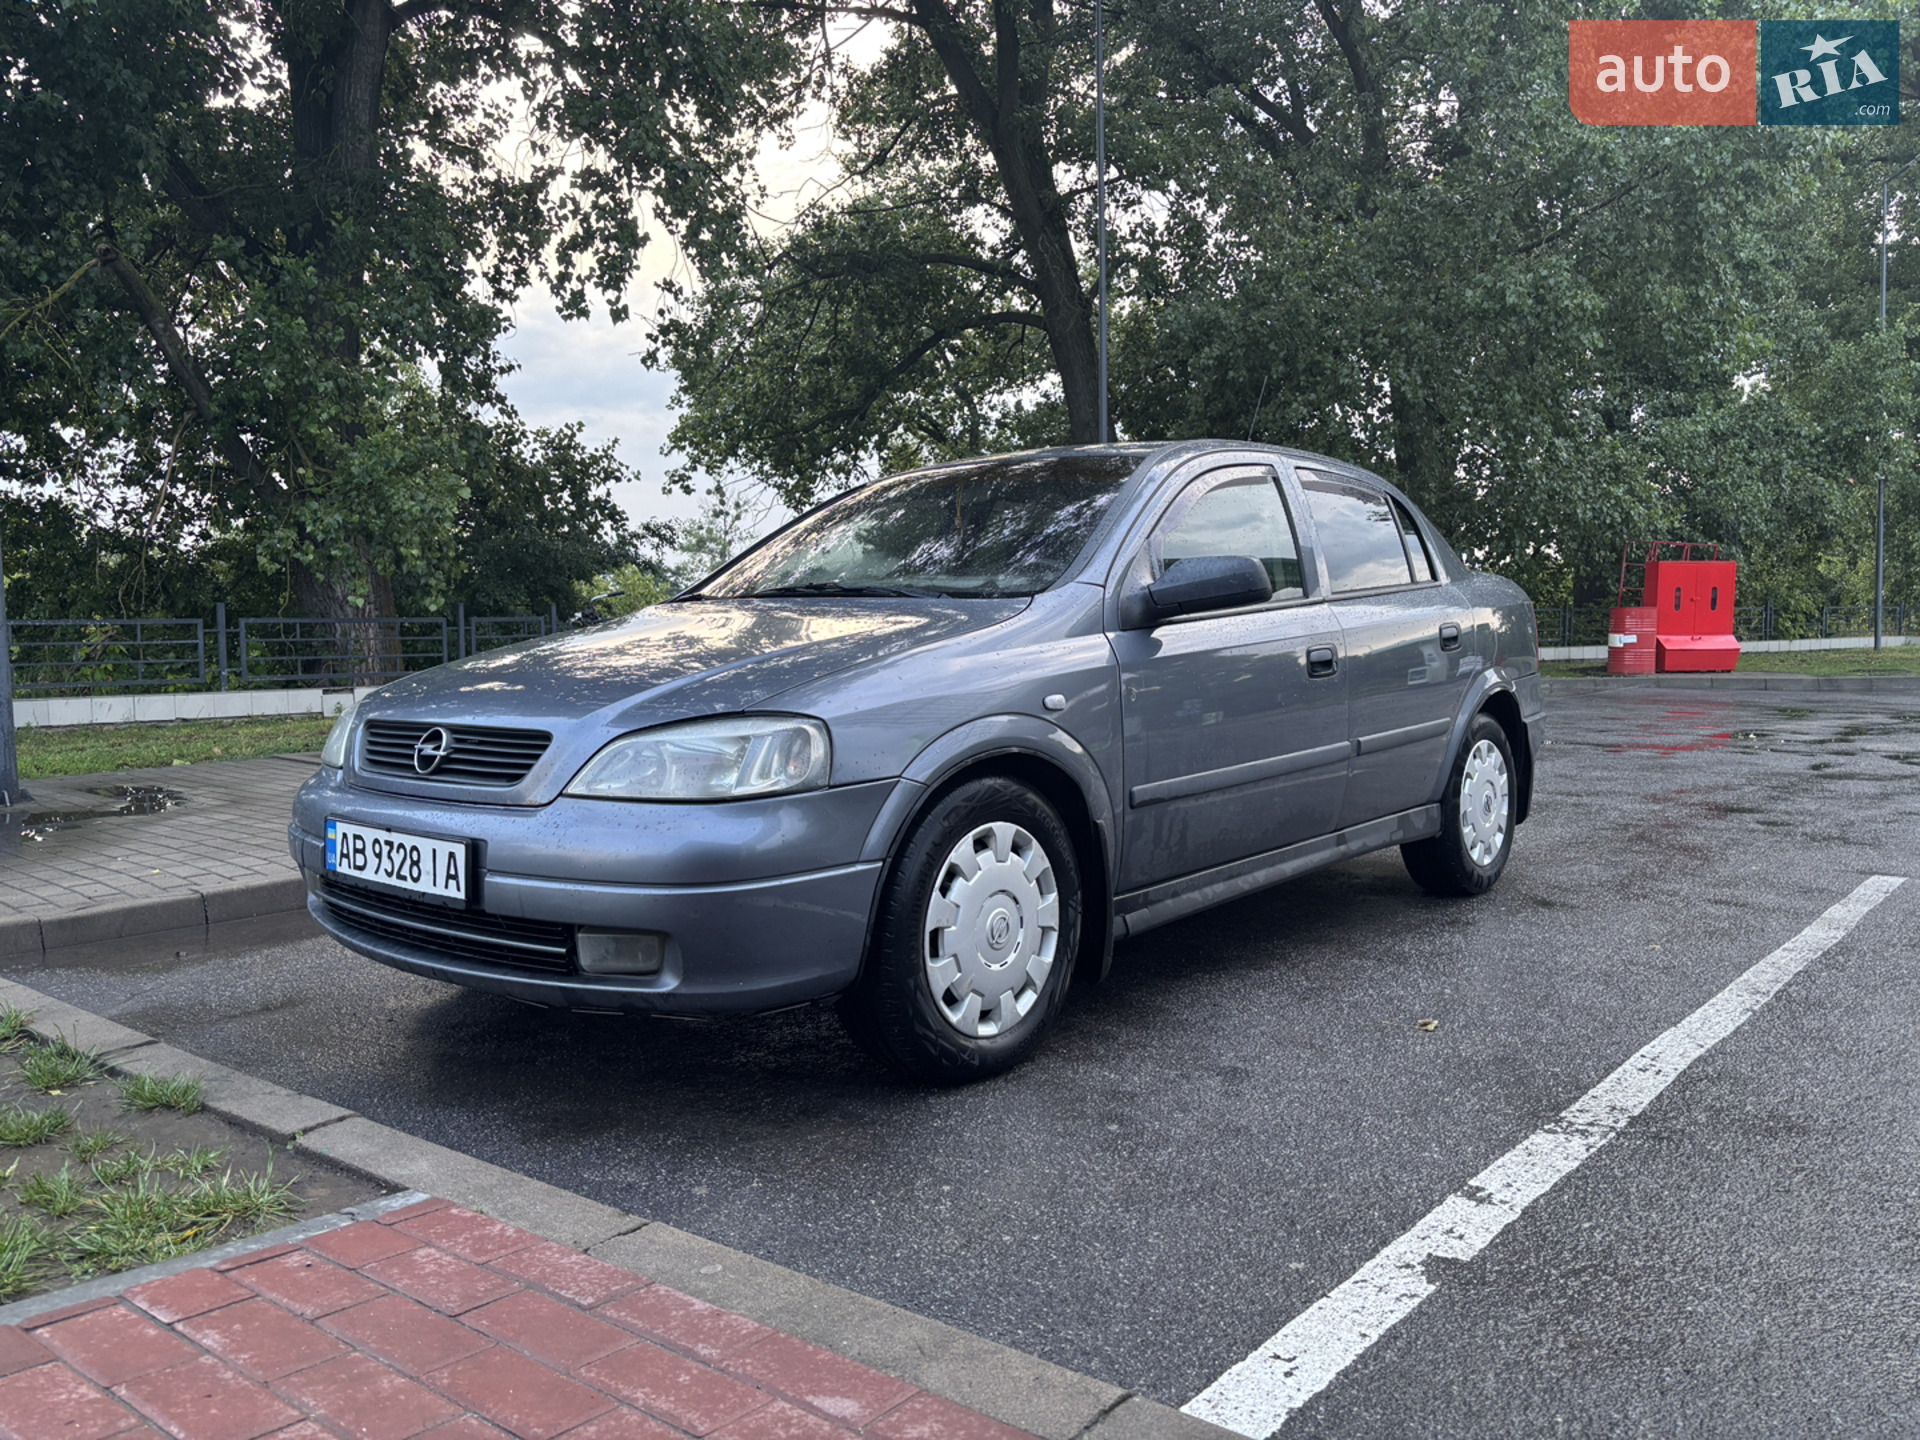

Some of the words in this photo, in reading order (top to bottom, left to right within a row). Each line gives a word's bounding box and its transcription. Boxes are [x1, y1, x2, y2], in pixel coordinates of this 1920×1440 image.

[338, 831, 368, 872] AB
[372, 837, 422, 884] 9328
[432, 847, 461, 892] IA
